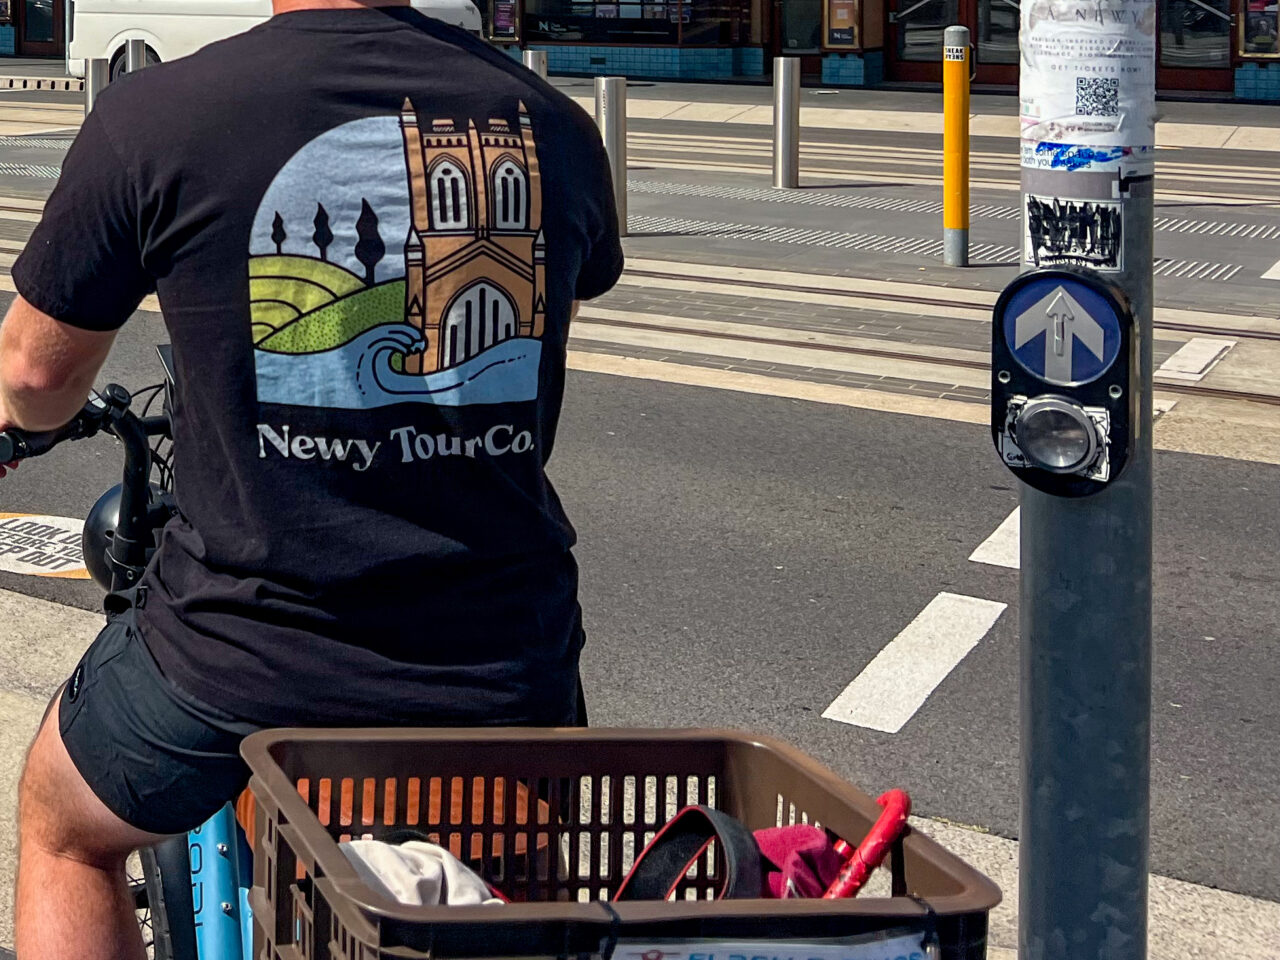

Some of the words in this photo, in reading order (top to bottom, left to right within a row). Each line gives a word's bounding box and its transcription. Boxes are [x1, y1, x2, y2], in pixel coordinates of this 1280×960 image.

[1074, 64, 1115, 72] TICKETS
[256, 424, 381, 471] Newy
[16, 550, 81, 570] OUT
